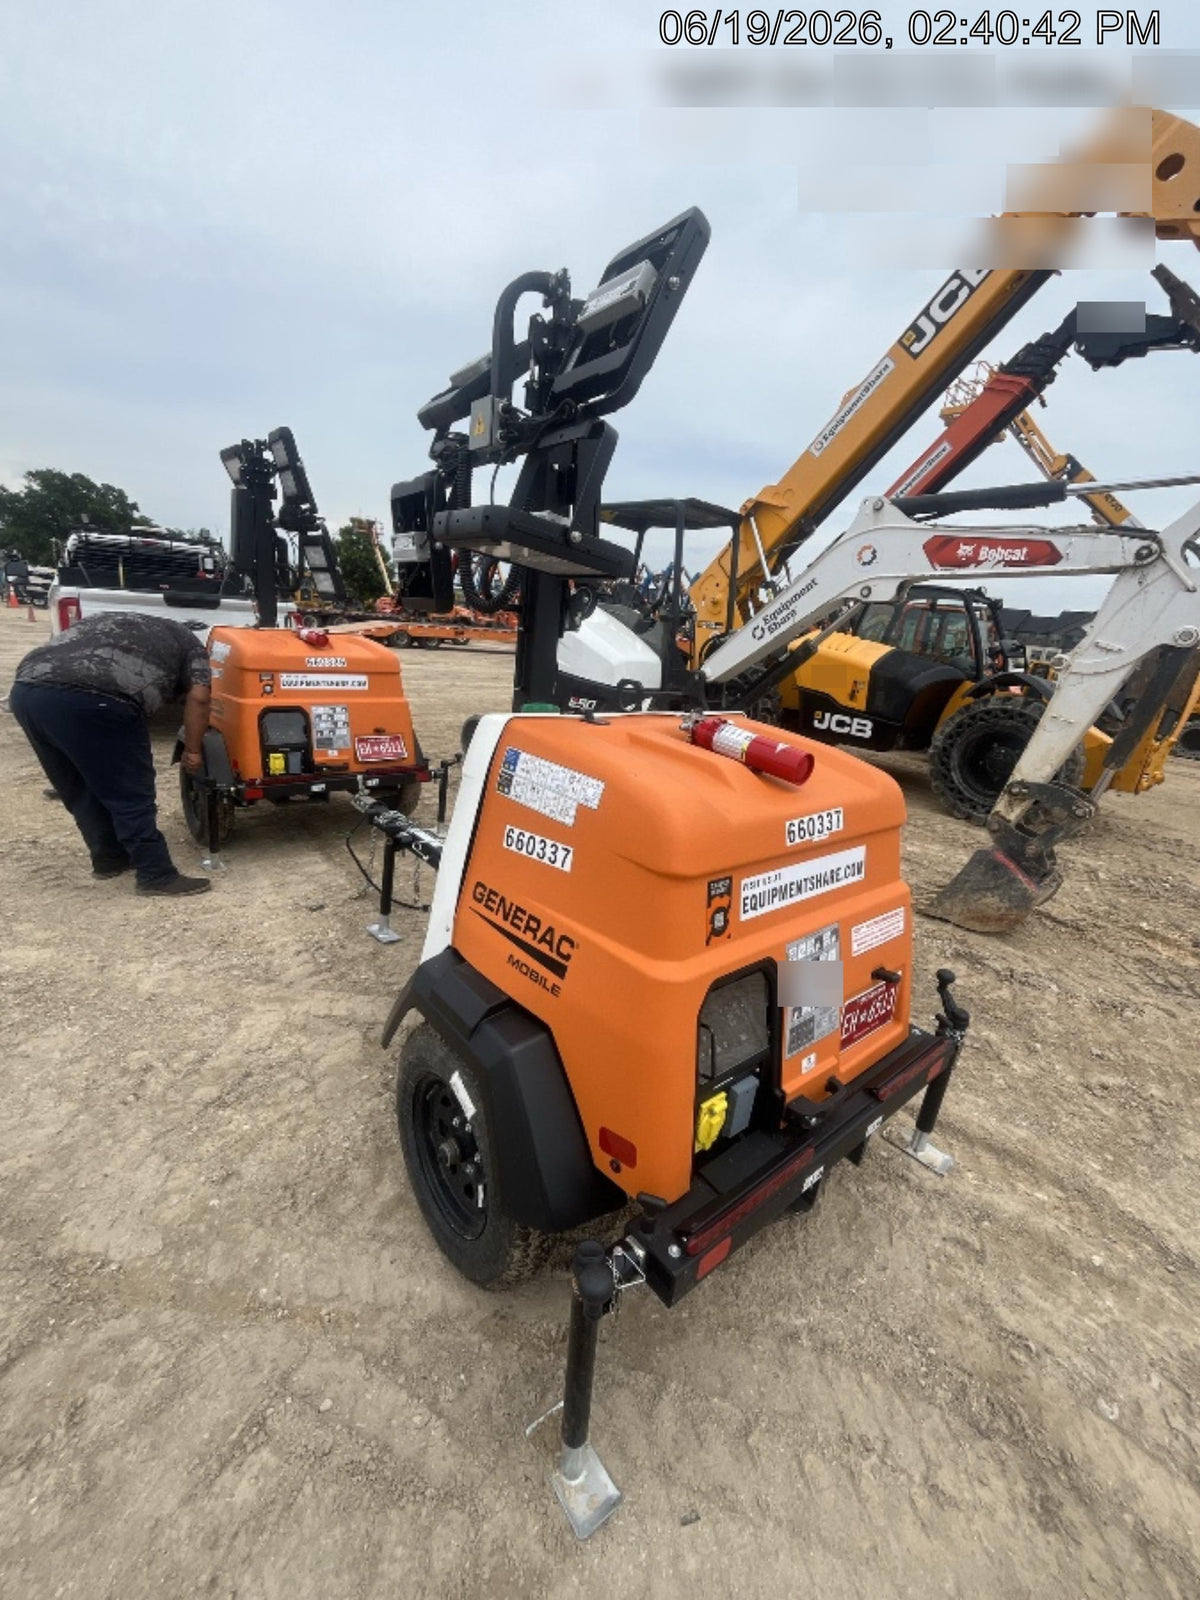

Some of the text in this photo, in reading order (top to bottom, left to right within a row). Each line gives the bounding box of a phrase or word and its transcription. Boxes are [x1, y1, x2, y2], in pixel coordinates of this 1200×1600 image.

[977, 543, 1029, 562] Bobcat
[762, 577, 819, 626] Equipment
[767, 609, 798, 635] Share
[813, 711, 874, 739] JCB
[787, 809, 842, 844] 660337
[505, 827, 572, 869] 660337
[742, 859, 864, 915] EQUIPMENTSHARE.COM
[472, 881, 576, 963] GENERAC
[506, 953, 562, 998] MOBILE
